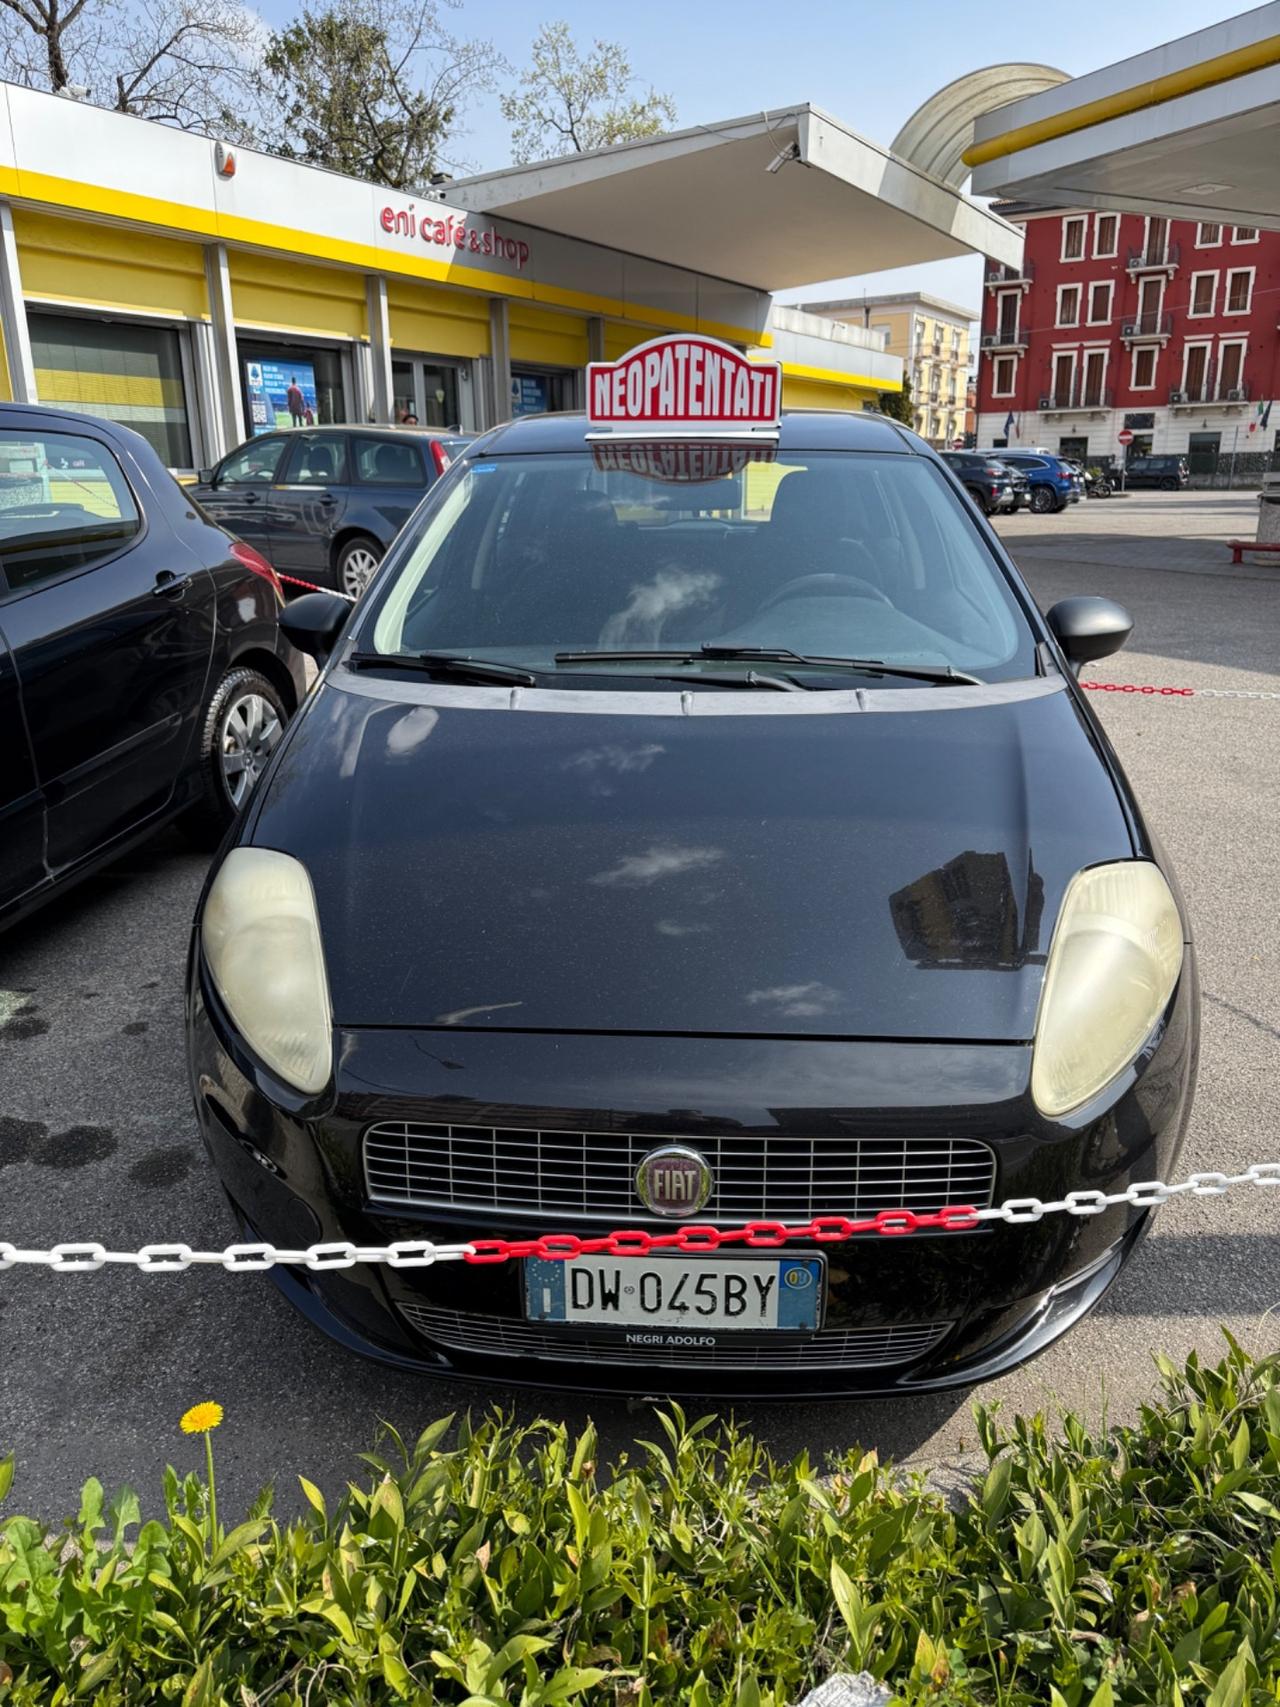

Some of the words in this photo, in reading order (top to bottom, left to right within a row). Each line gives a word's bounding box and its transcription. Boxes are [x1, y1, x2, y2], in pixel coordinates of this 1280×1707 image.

[380, 204, 416, 238] eni
[420, 215, 466, 250] café
[481, 226, 530, 270] shop
[594, 343, 773, 417] NEOPATENTATI
[654, 1169, 697, 1200] FIAT
[571, 1267, 621, 1311] DW
[639, 1272, 776, 1317] 045BY
[626, 1334, 663, 1344] NEGRI
[666, 1335, 716, 1345] ADOLFO
